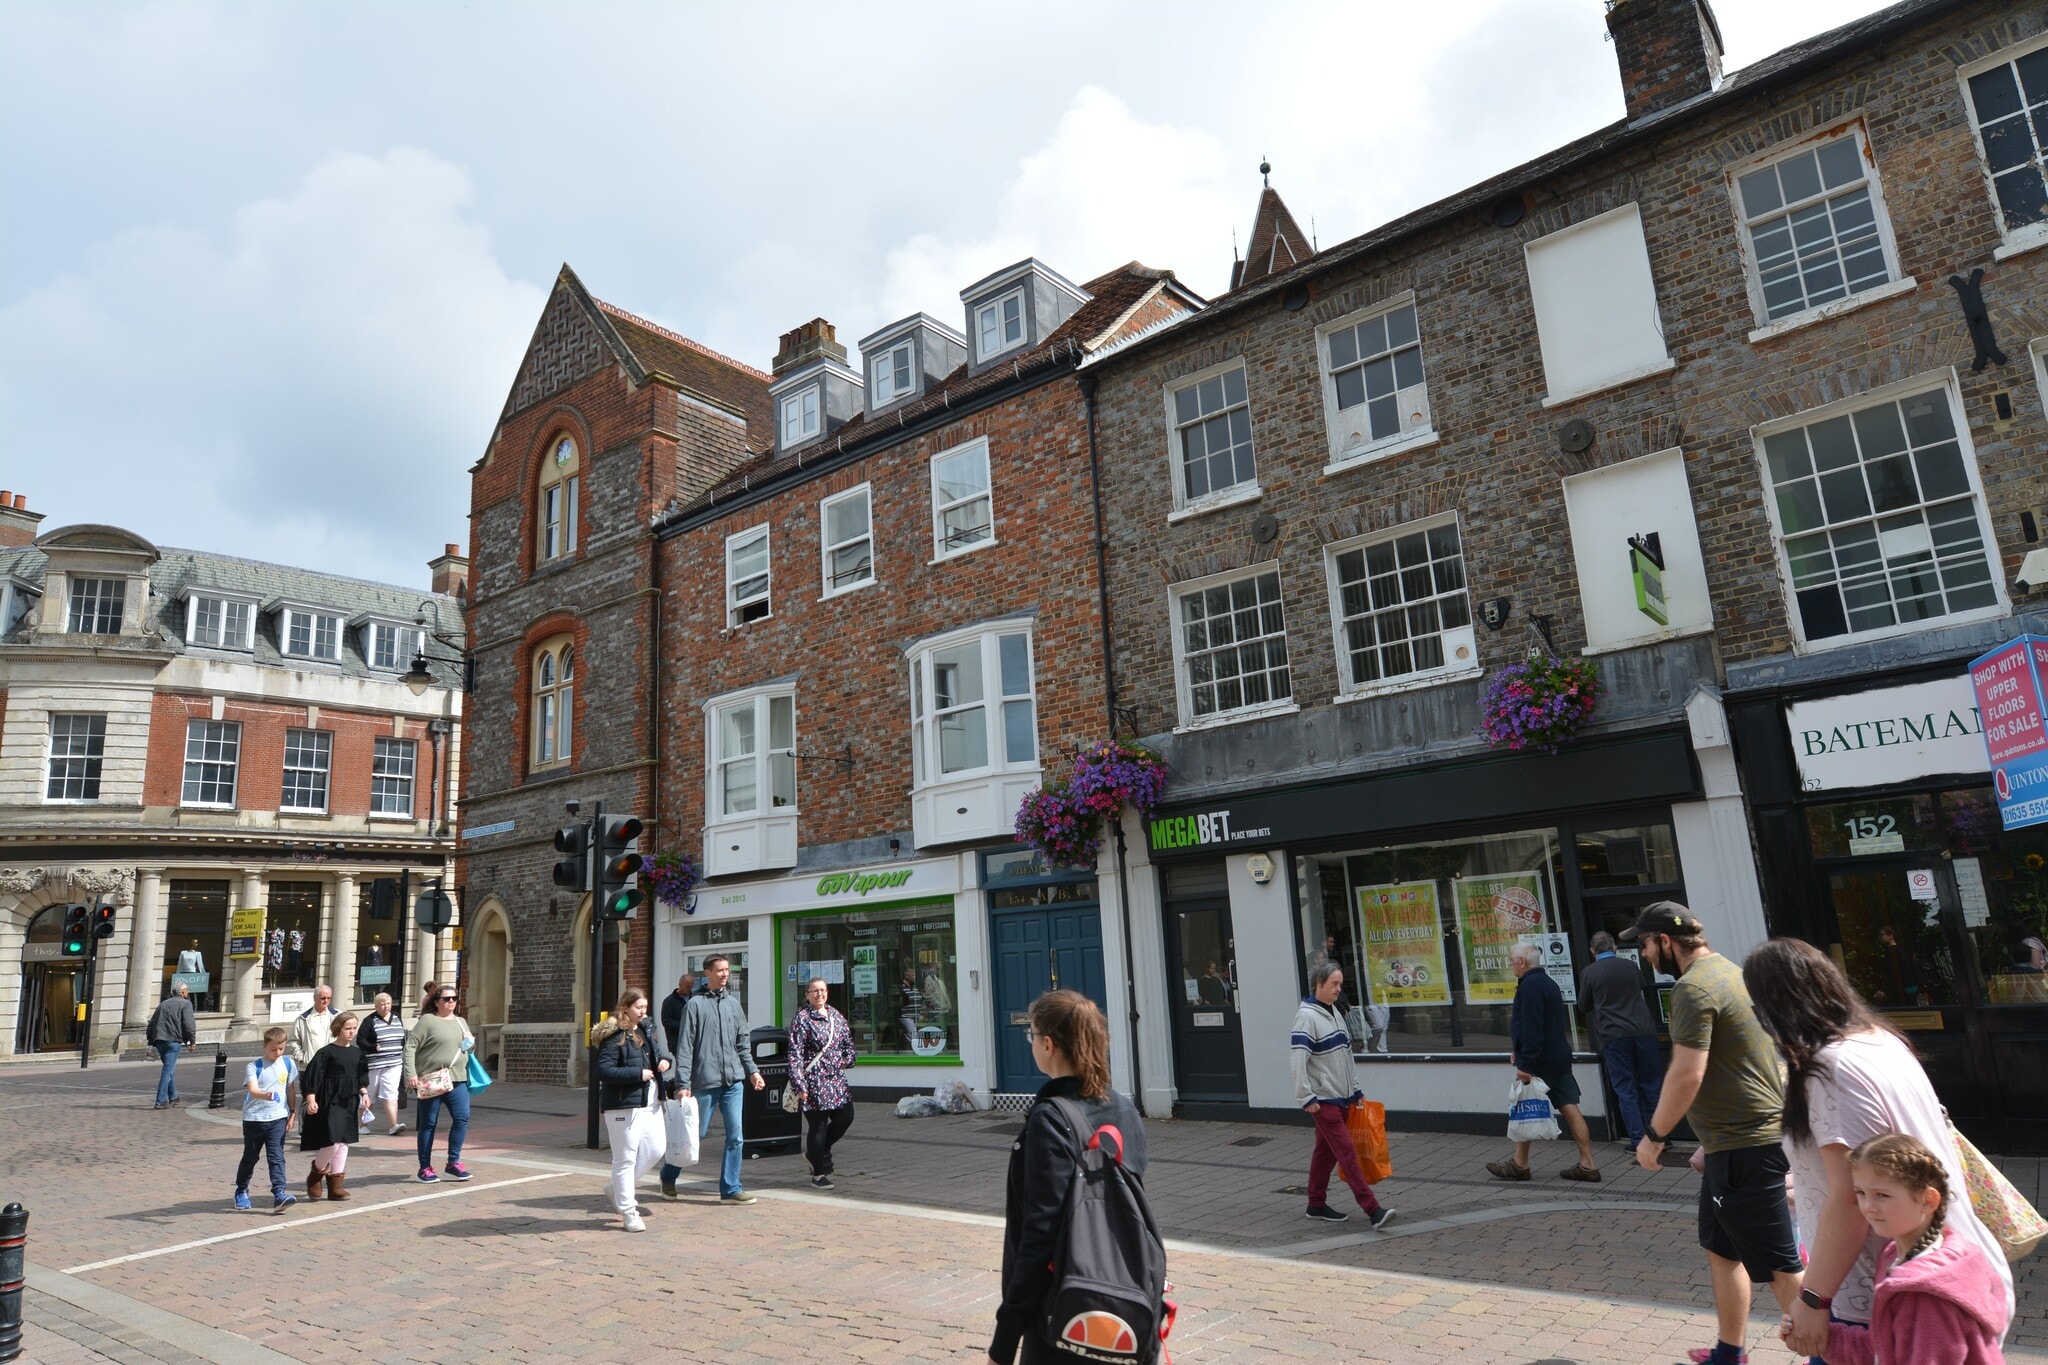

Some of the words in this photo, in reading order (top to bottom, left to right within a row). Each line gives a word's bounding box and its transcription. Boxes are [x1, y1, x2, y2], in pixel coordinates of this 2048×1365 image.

[1974, 664, 1997, 687] SHOP
[1998, 650, 2026, 674] WITH
[1986, 677, 2019, 701] UPPER
[1988, 695, 2026, 721] FLOORS
[1987, 724, 2008, 744] FOR
[2008, 711, 2039, 736] SALE
[1991, 736, 2046, 761] www.quintons.co.uk
[1801, 778, 1822, 792] 152
[2004, 805, 2028, 822] 01635
[1151, 811, 1230, 850] MEGABET
[1231, 832, 1246, 840] PLACE
[1246, 829, 1258, 838] YOUR
[1258, 827, 1271, 837] BETS
[1844, 814, 1899, 840] 152
[721, 896, 732, 904] Est
[732, 895, 746, 903] 2013
[1366, 905, 1396, 928] PLAY
[1398, 902, 1432, 925] HERE
[707, 928, 722, 940] 154
[901, 924, 919, 932] FRIENDLY
[923, 921, 950, 931] PROFESSIONAL
[1369, 930, 1381, 941] ALL
[1382, 929, 1396, 940] DAY
[1397, 926, 1434, 939] EVERYDAY
[1473, 947, 1483, 957] ON
[1484, 946, 1499, 956] ALL
[1475, 957, 1502, 970] EARLY
